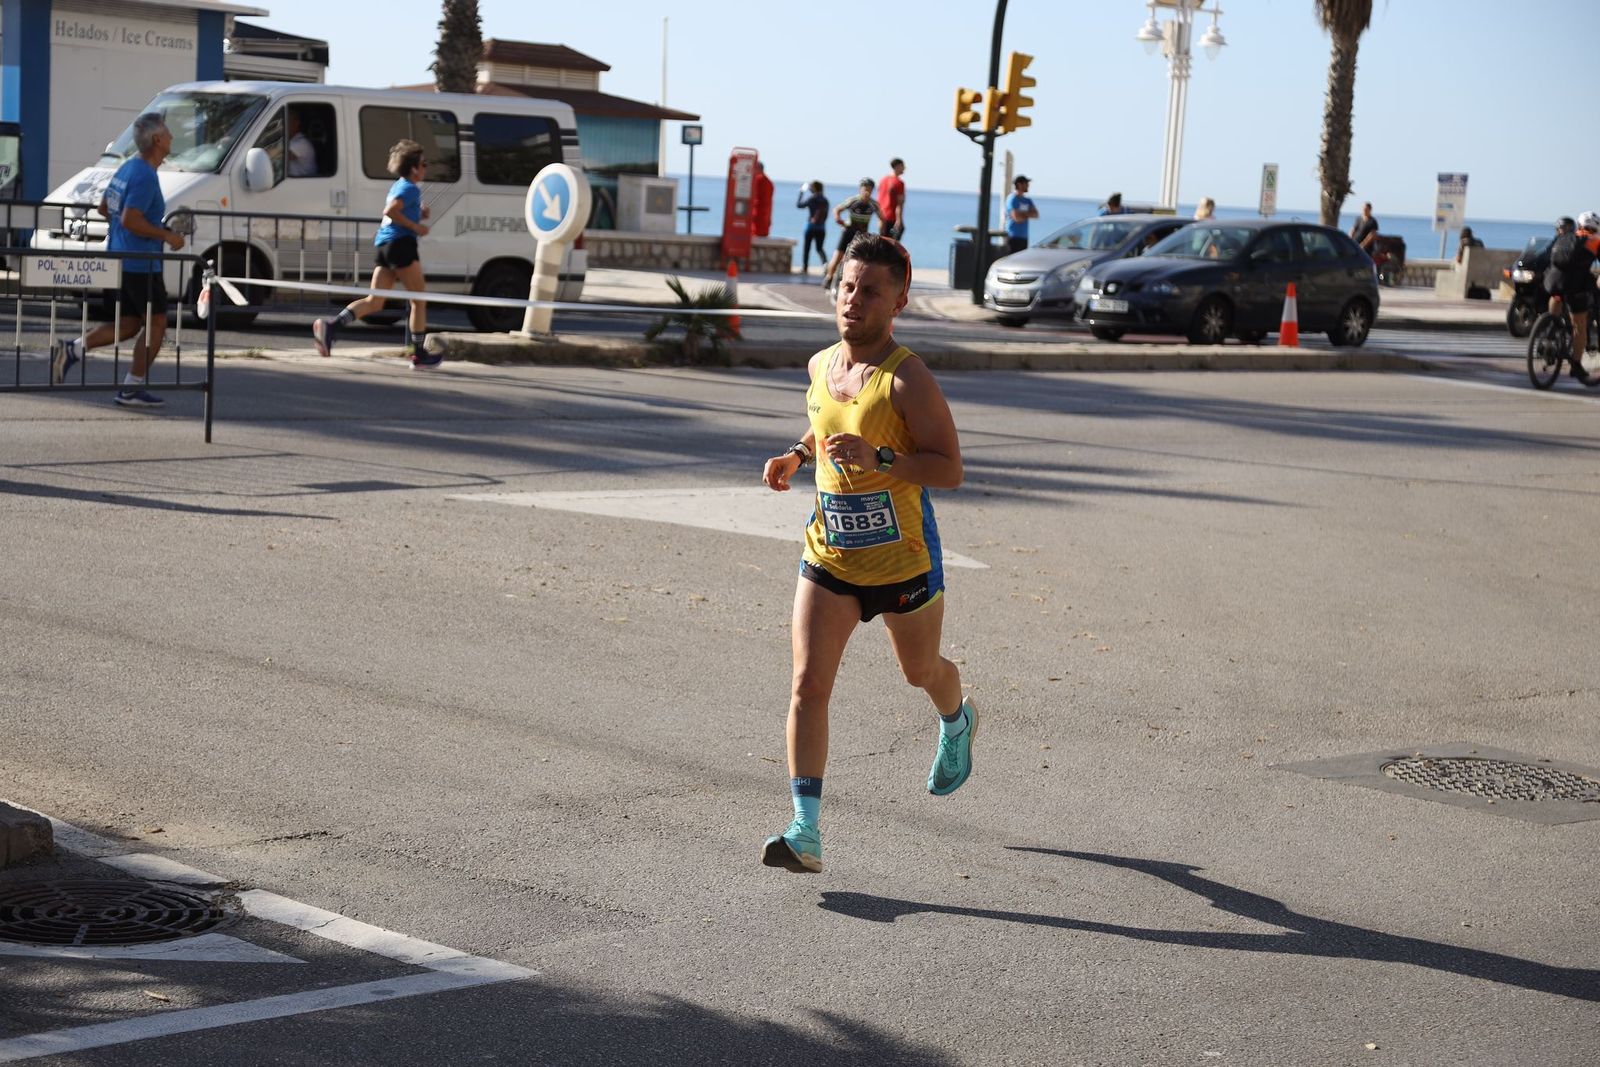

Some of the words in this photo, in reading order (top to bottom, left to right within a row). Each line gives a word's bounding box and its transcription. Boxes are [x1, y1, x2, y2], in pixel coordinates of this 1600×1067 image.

[55, 20, 110, 41] Helados
[111, 26, 118, 42] /
[121, 27, 141, 45] Ice
[144, 29, 193, 50] Creams
[454, 215, 529, 237] HARLEY-DA
[37, 260, 74, 271] POLA
[77, 261, 107, 272] LOCAL
[53, 273, 92, 285] MALAGA
[829, 511, 887, 531] 1683
